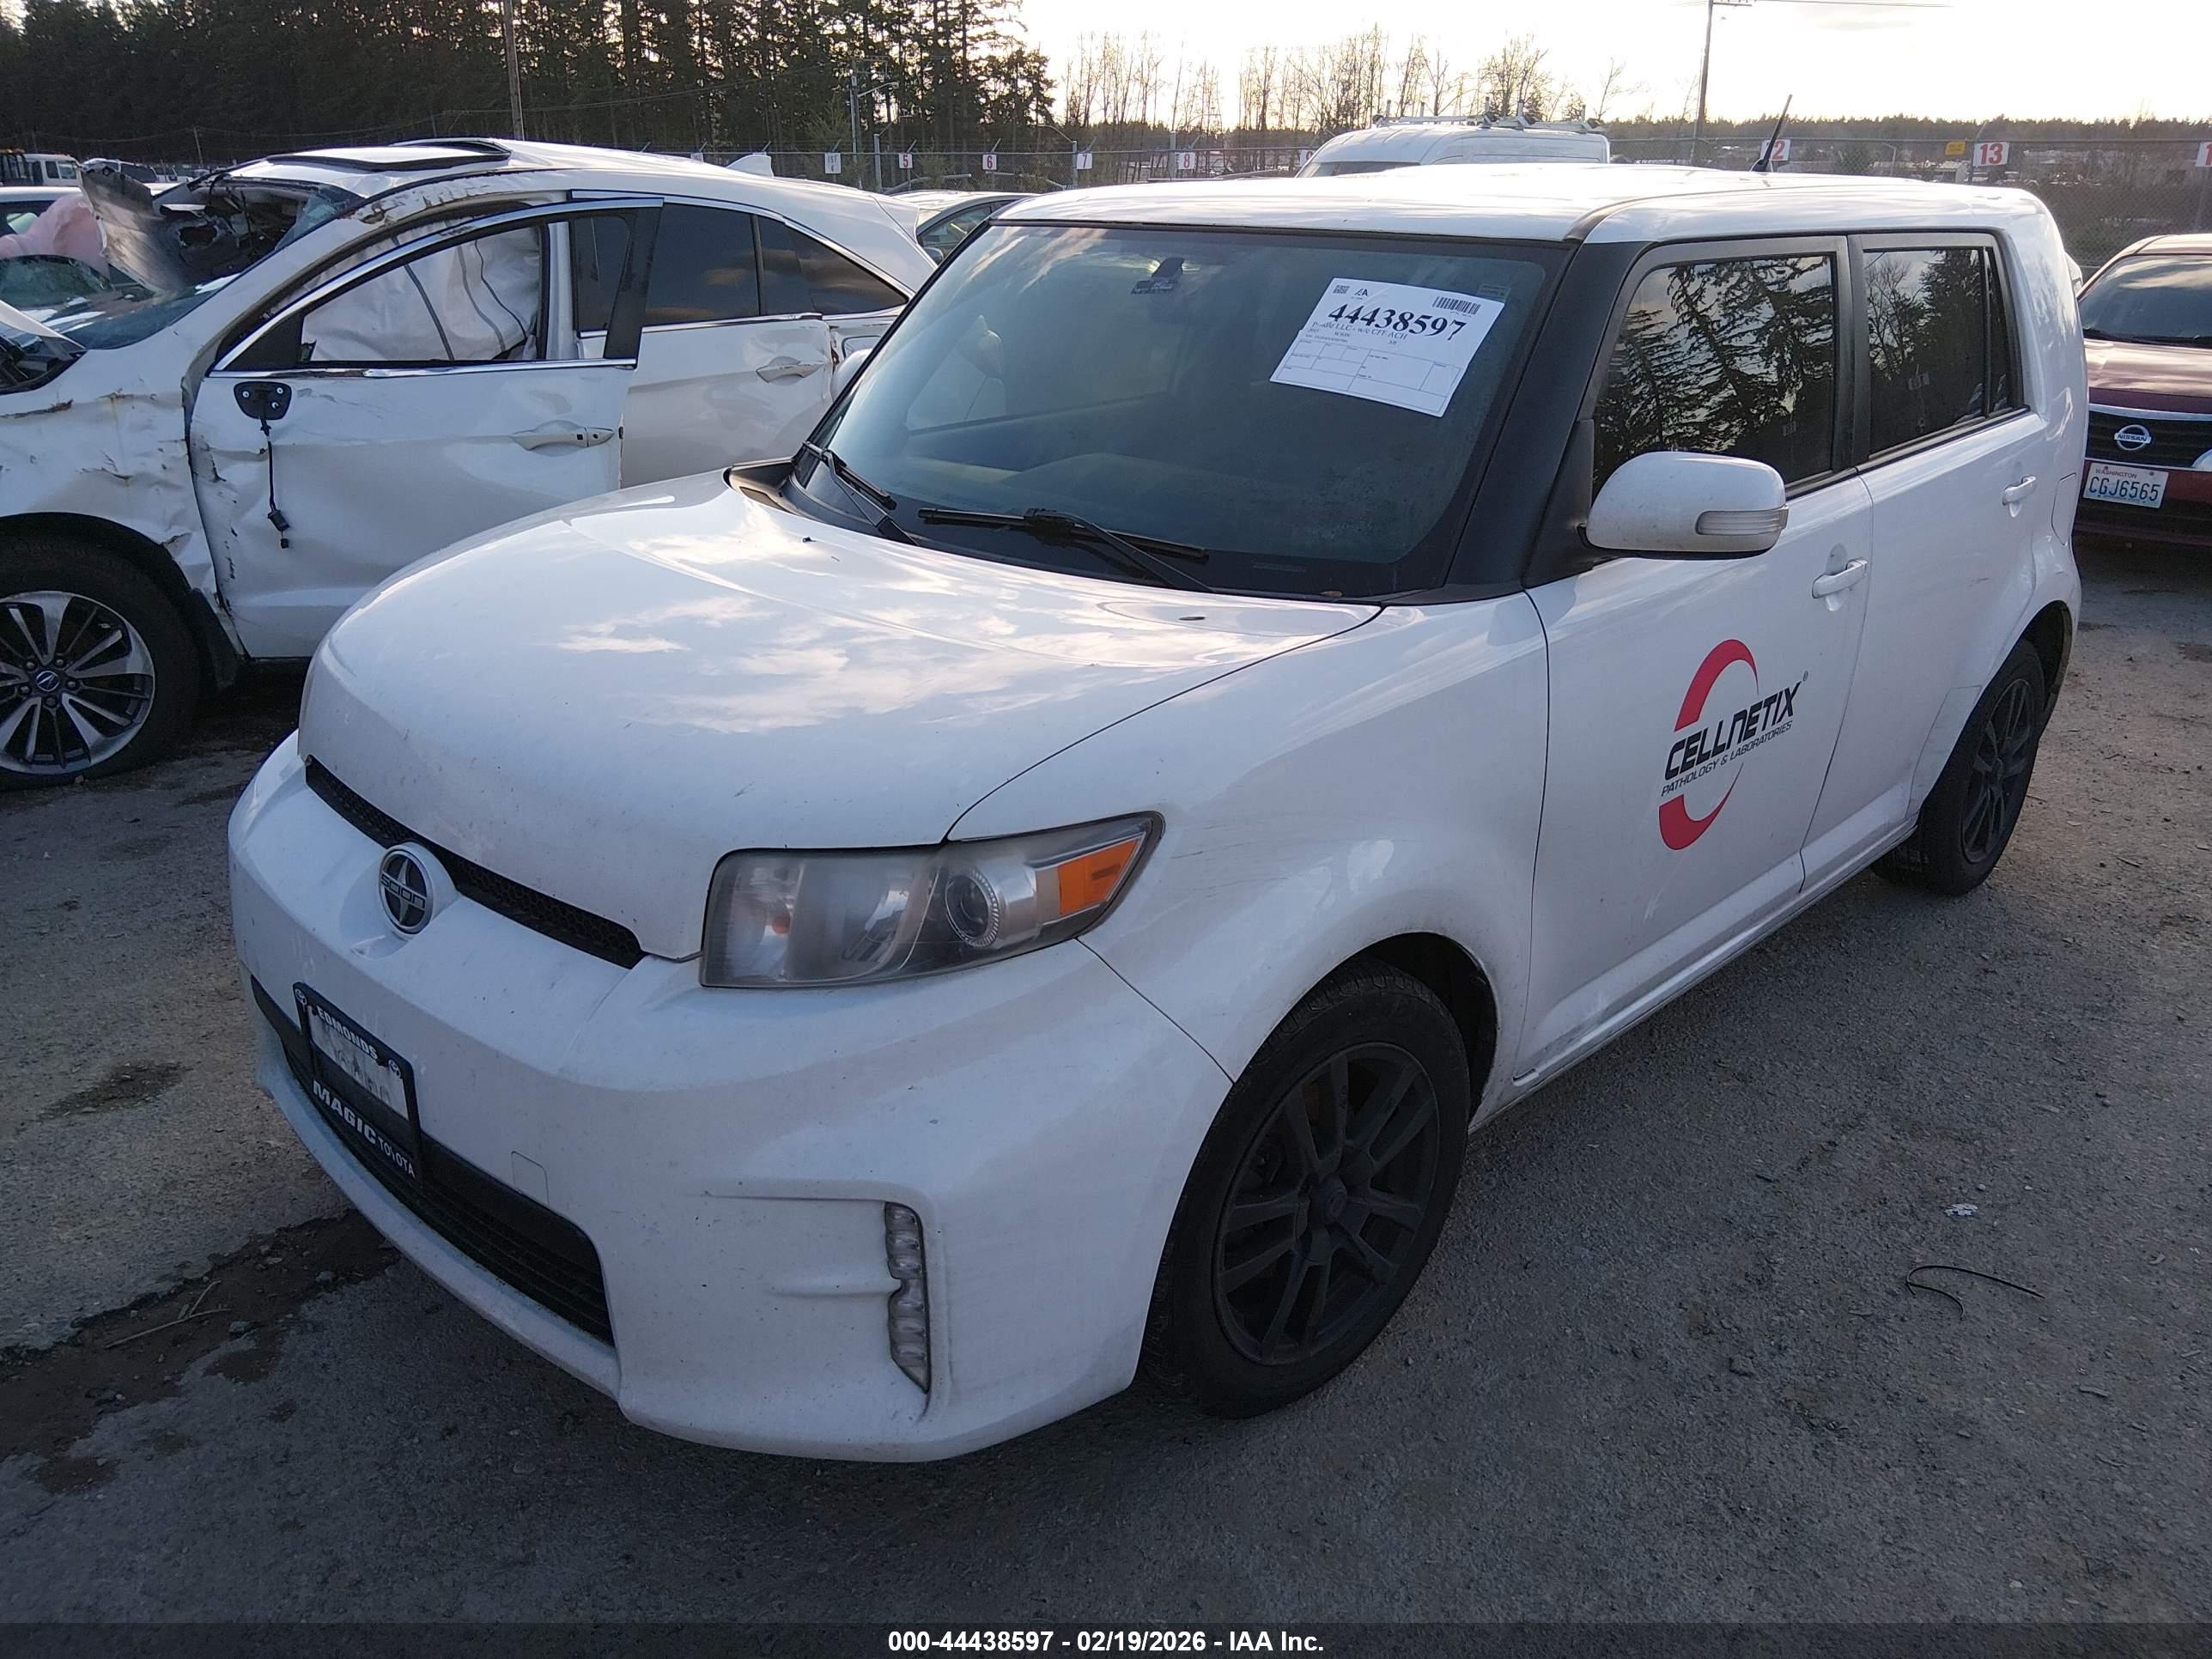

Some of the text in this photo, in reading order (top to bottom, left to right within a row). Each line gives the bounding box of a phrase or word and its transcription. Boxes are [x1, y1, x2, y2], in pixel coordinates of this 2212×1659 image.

[1766, 140, 1785, 160] 2
[1980, 143, 2003, 165] 13
[902, 155, 909, 167] 5
[987, 155, 994, 169] 6
[1082, 155, 1089, 168] 7
[1183, 153, 1190, 168] 8
[1328, 303, 1467, 340] 44438597
[2117, 433, 2148, 442] NISSAN
[2095, 468, 2136, 479] WASHINGTON
[2089, 476, 2161, 501] CGJ6565
[1661, 720, 1793, 797] PATHOLOGY & LABORATORIES
[317, 1006, 378, 1060] EDMONDS
[313, 1079, 377, 1144] MAGIC
